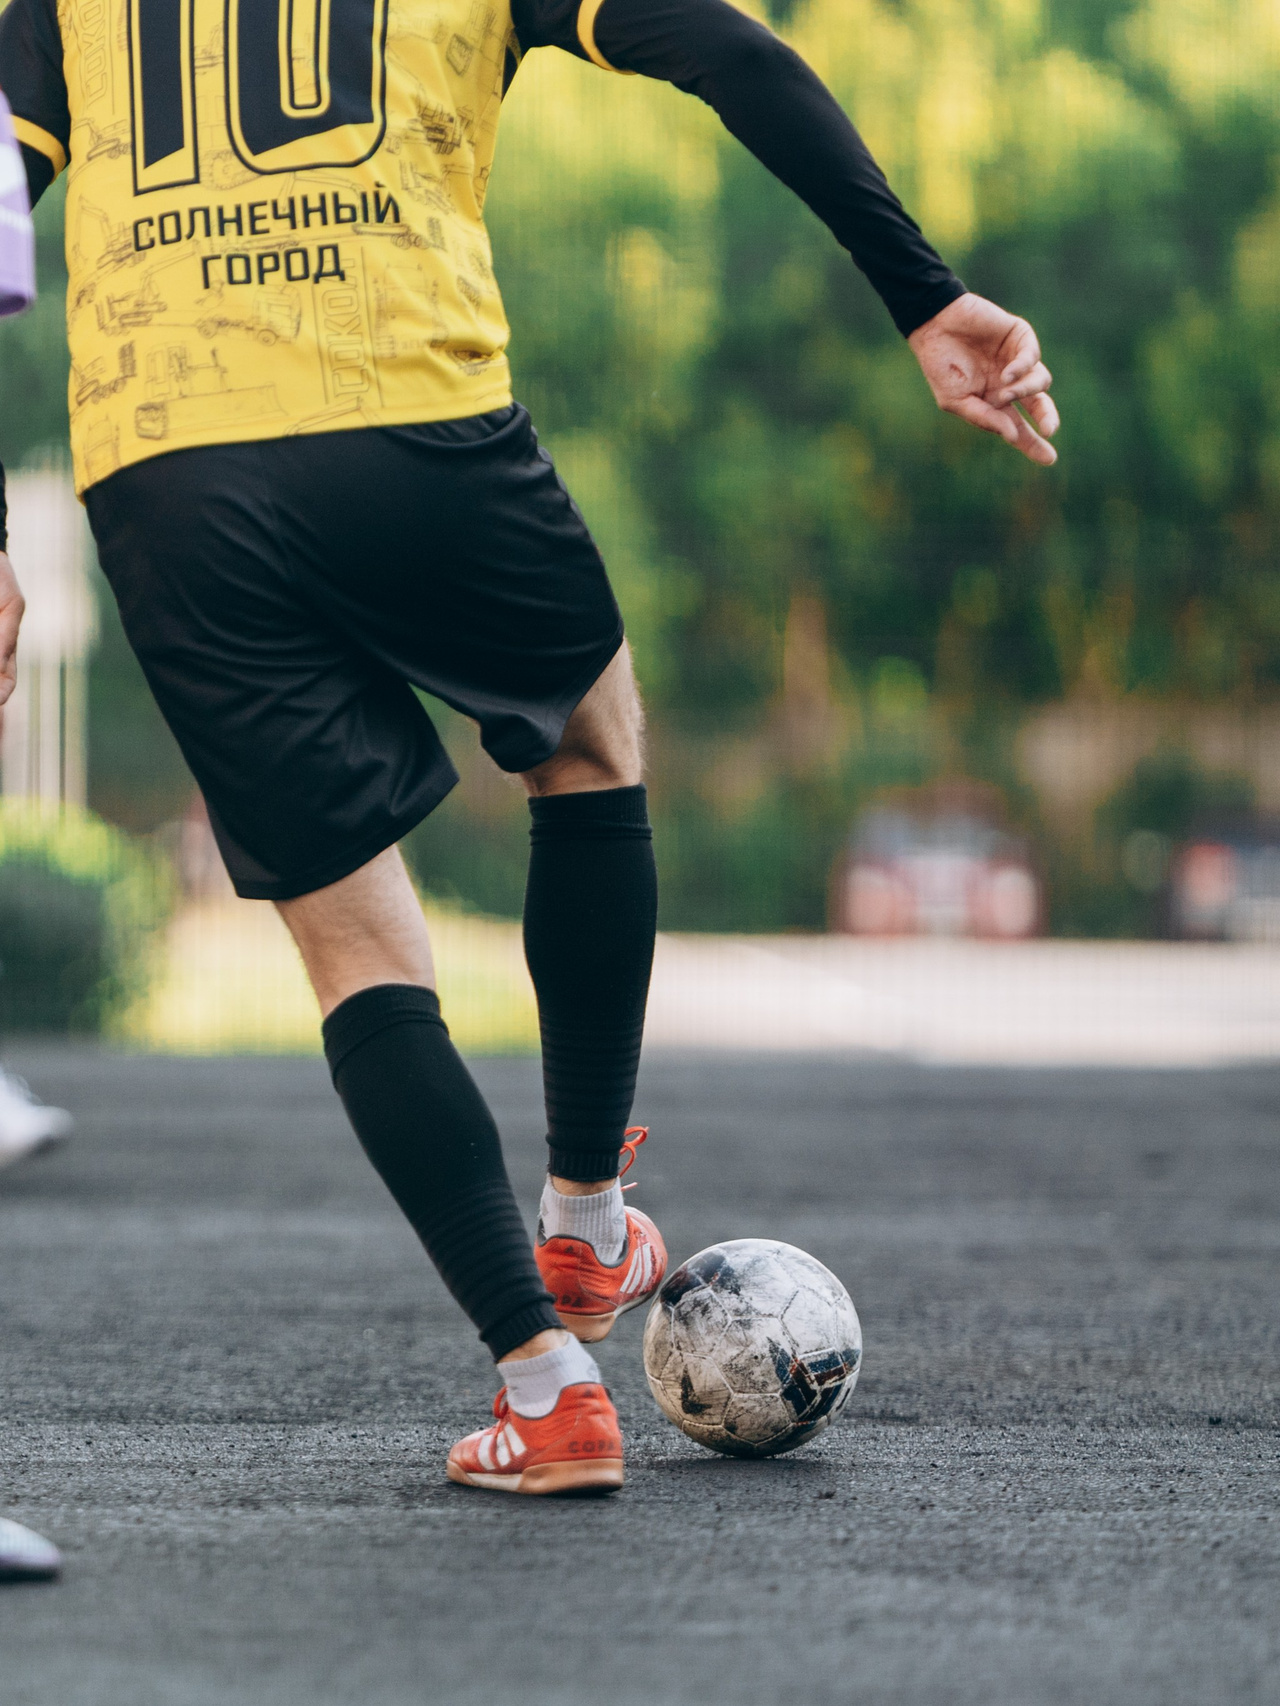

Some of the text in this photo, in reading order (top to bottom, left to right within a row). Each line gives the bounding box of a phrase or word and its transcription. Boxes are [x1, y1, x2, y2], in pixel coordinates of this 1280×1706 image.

[126, 0, 387, 196] 10
[133, 180, 401, 252] СОЛНЕЧНЫЙ
[201, 243, 346, 290] ГОРОД
[568, 1440, 616, 1454] COPA
